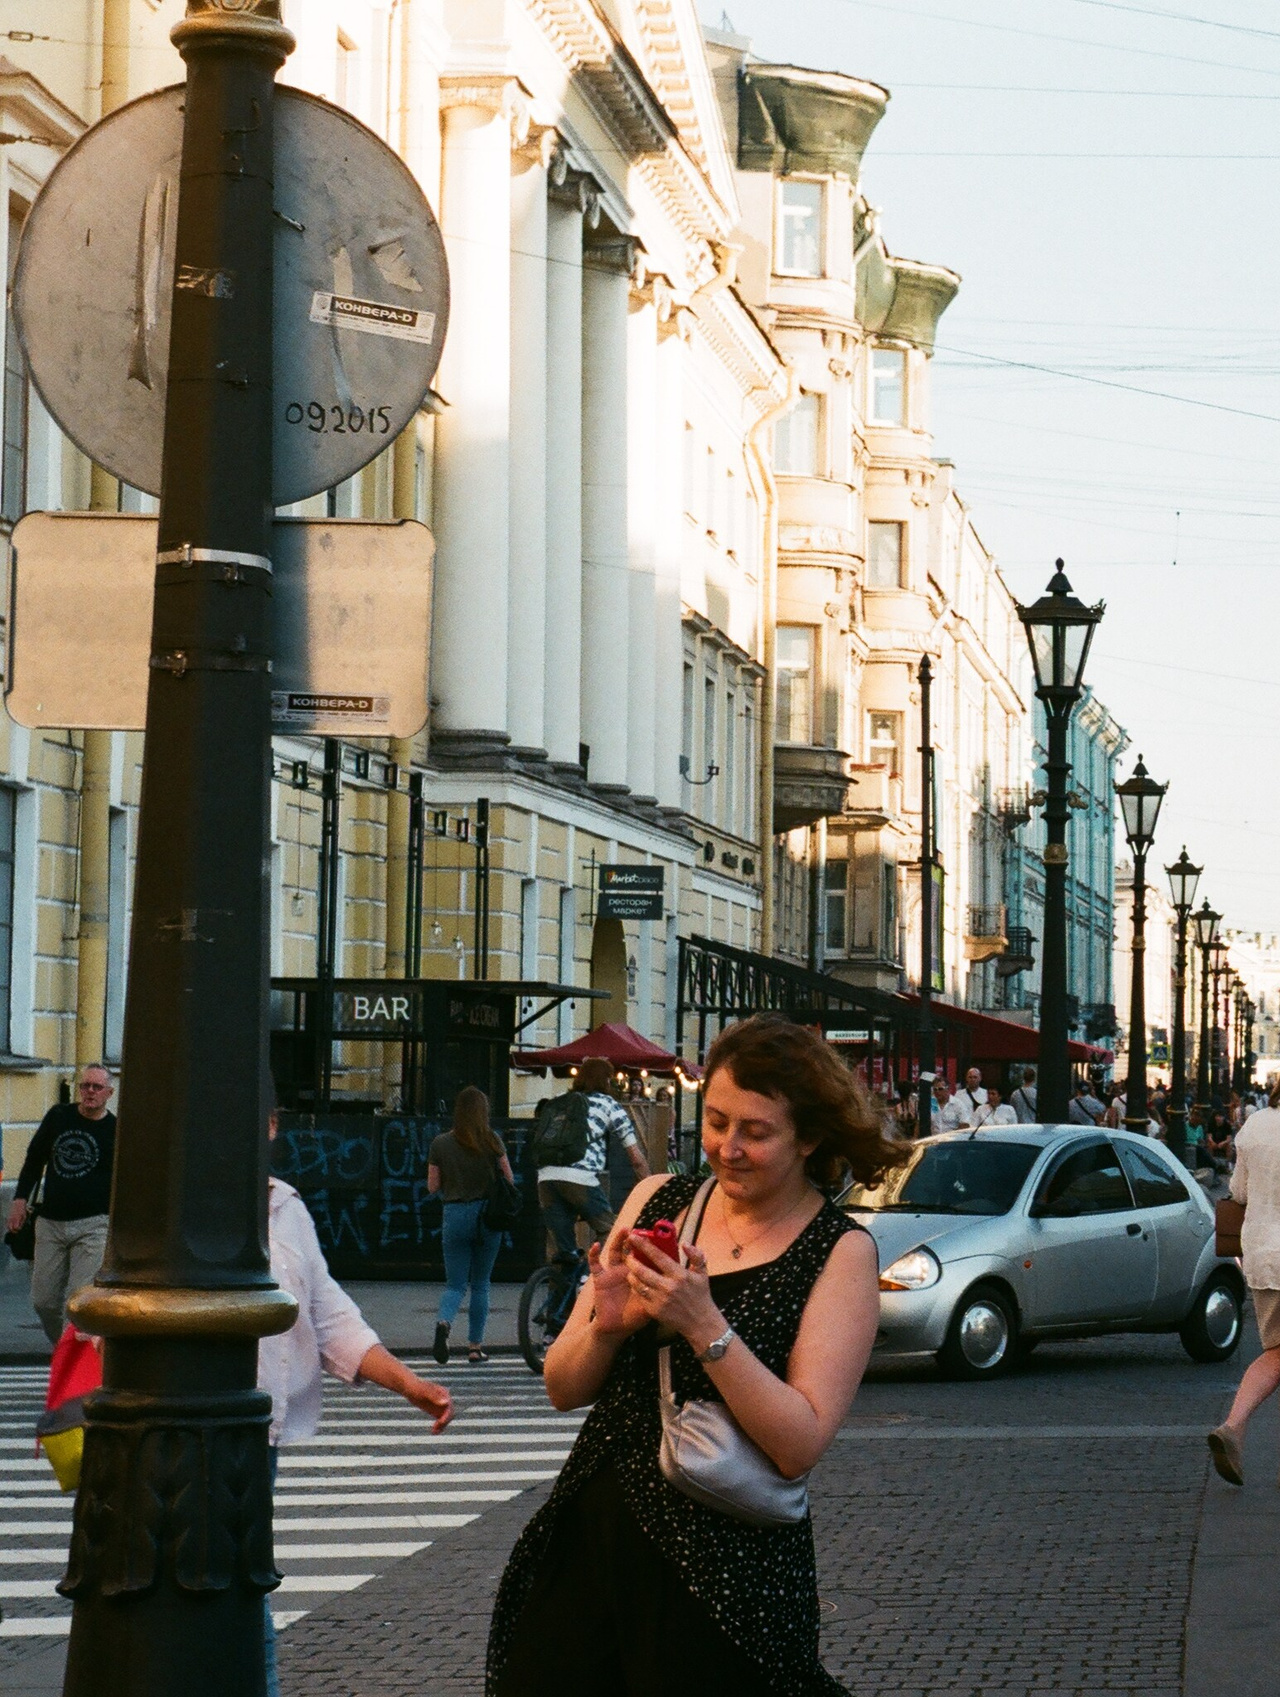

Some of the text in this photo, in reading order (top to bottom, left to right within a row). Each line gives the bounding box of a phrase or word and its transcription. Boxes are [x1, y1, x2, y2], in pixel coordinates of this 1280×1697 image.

[334, 300, 413, 322] КОНВЕРА-D
[285, 401, 393, 434] 09.2015
[293, 698, 369, 708] КОНВЕРА-D
[354, 996, 410, 1021] BAR
